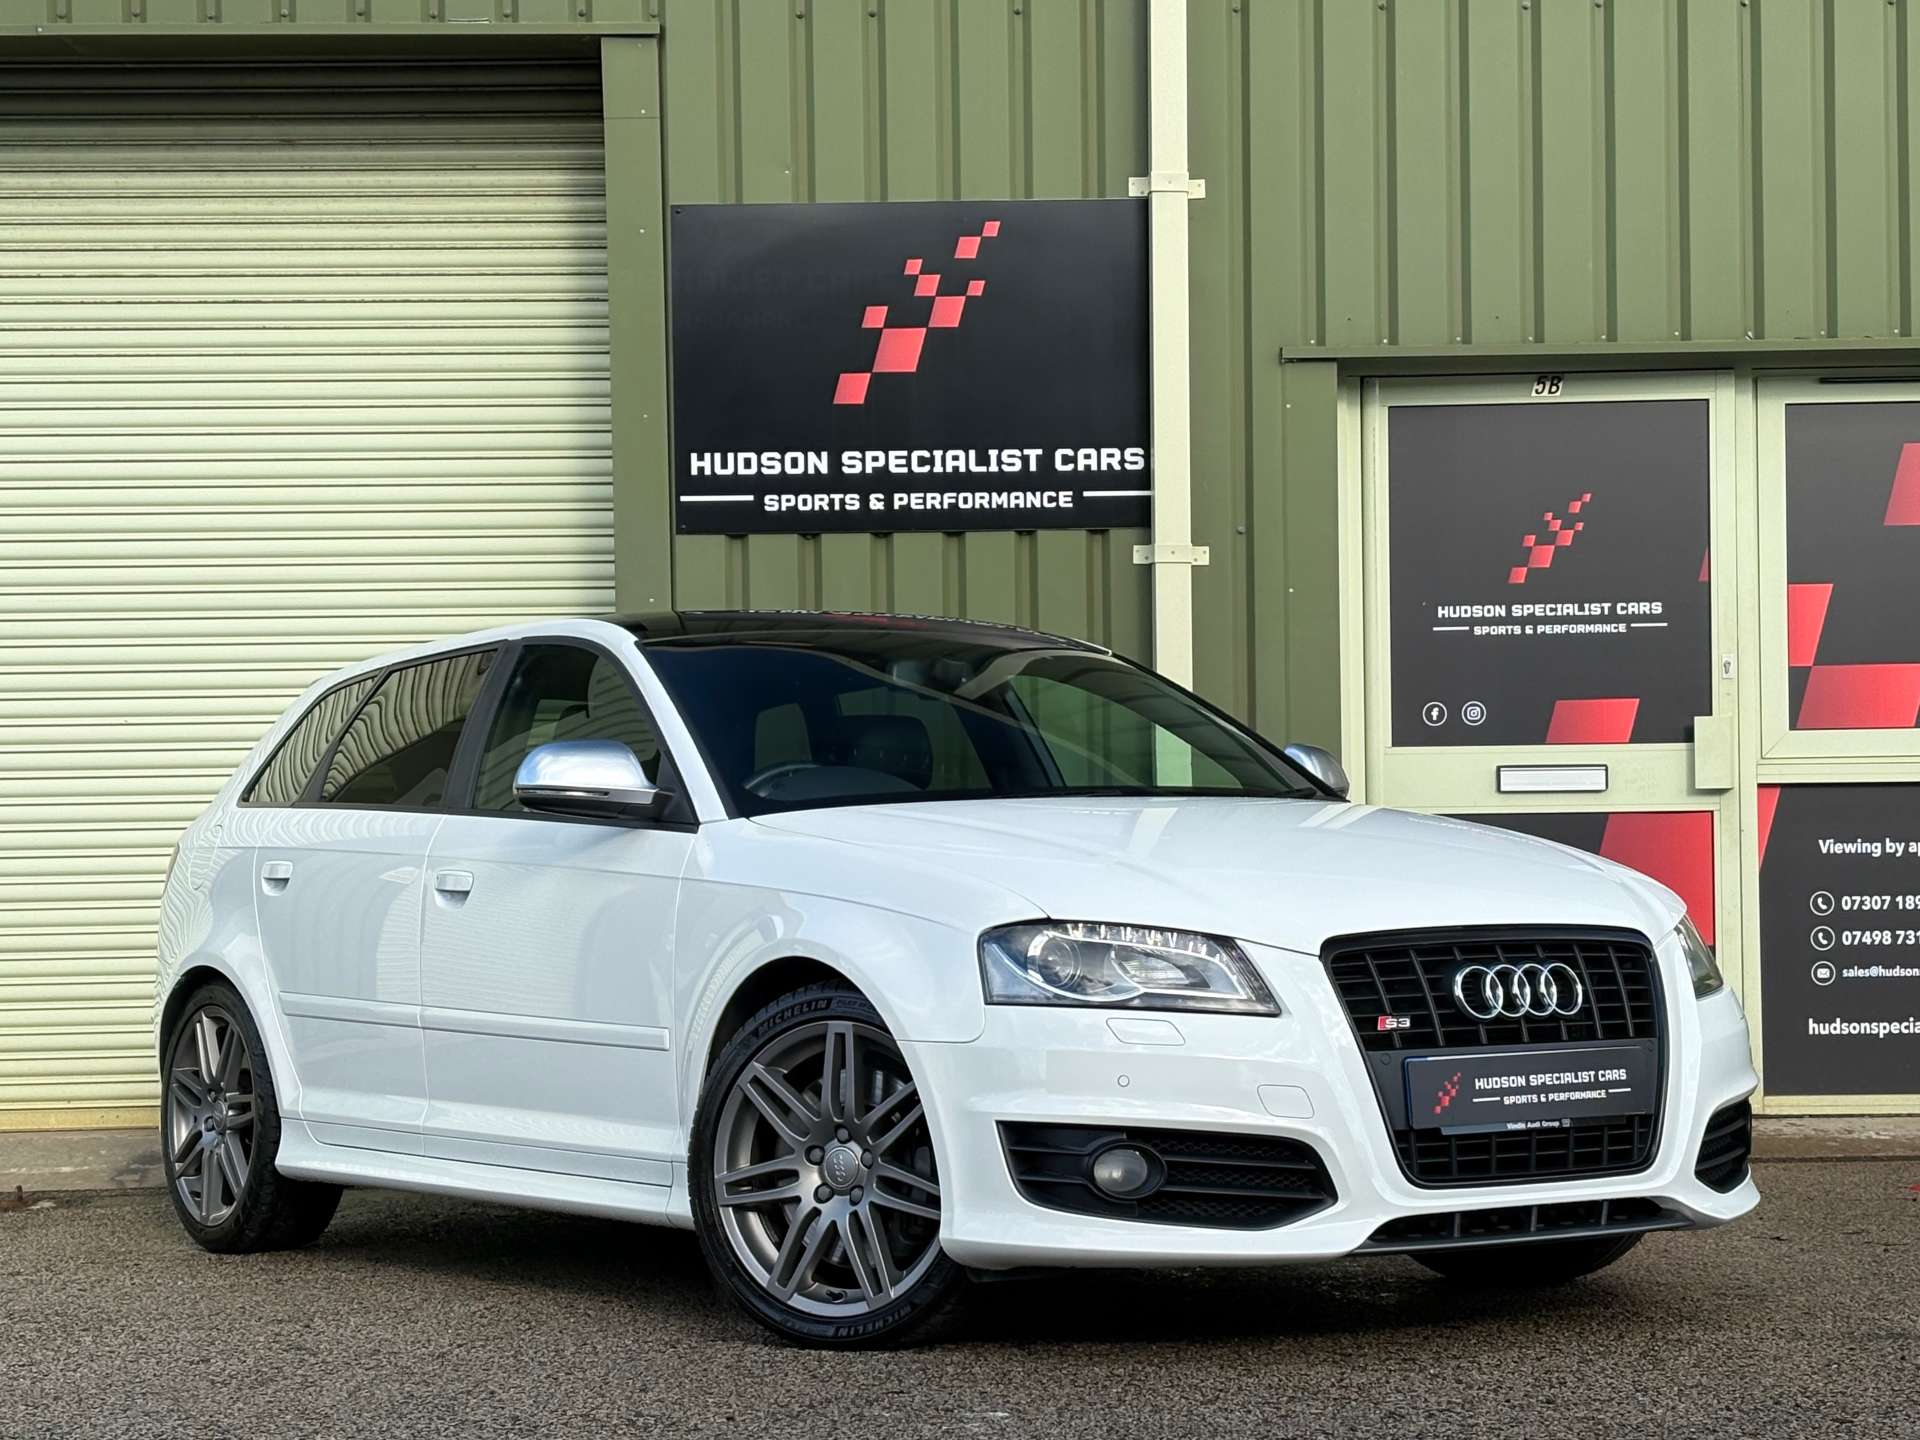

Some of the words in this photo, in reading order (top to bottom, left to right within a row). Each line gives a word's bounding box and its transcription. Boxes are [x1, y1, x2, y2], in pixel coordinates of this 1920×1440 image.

[1534, 375, 1562, 395] 5B
[691, 452, 828, 475] HUDSON
[842, 449, 1042, 473] SPECIALIST
[1055, 448, 1144, 471] CARS
[764, 494, 860, 511] SPORTS
[869, 494, 884, 510] &
[894, 491, 1073, 509] PERFORMANCE
[1438, 605, 1505, 618] HUDSON
[1512, 603, 1611, 616] SPECIALIST
[1617, 602, 1662, 614] CARS
[1474, 625, 1521, 635] SPORTS
[1525, 625, 1533, 634] &
[1537, 624, 1627, 634] PERFORMANCE
[1819, 839, 1881, 857] Viewing
[1886, 838, 1905, 857] by
[1908, 841, 1920, 857] a
[1842, 896, 1890, 910] 07307
[1842, 931, 1891, 945] 07498
[1896, 930, 1920, 944] 731
[1843, 966, 1920, 977] sales@hudson
[757, 1000, 828, 1035] MICHELIN
[1385, 1017, 1411, 1028] S3
[1809, 1017, 1920, 1038] hudsonspecia
[1475, 1076, 1526, 1089] HUDSON
[1529, 1071, 1595, 1085] SPECIALIST
[1598, 1069, 1626, 1081] CARS
[1504, 1095, 1538, 1104] SPORTS
[1548, 1090, 1606, 1101] PERFORMANCE
